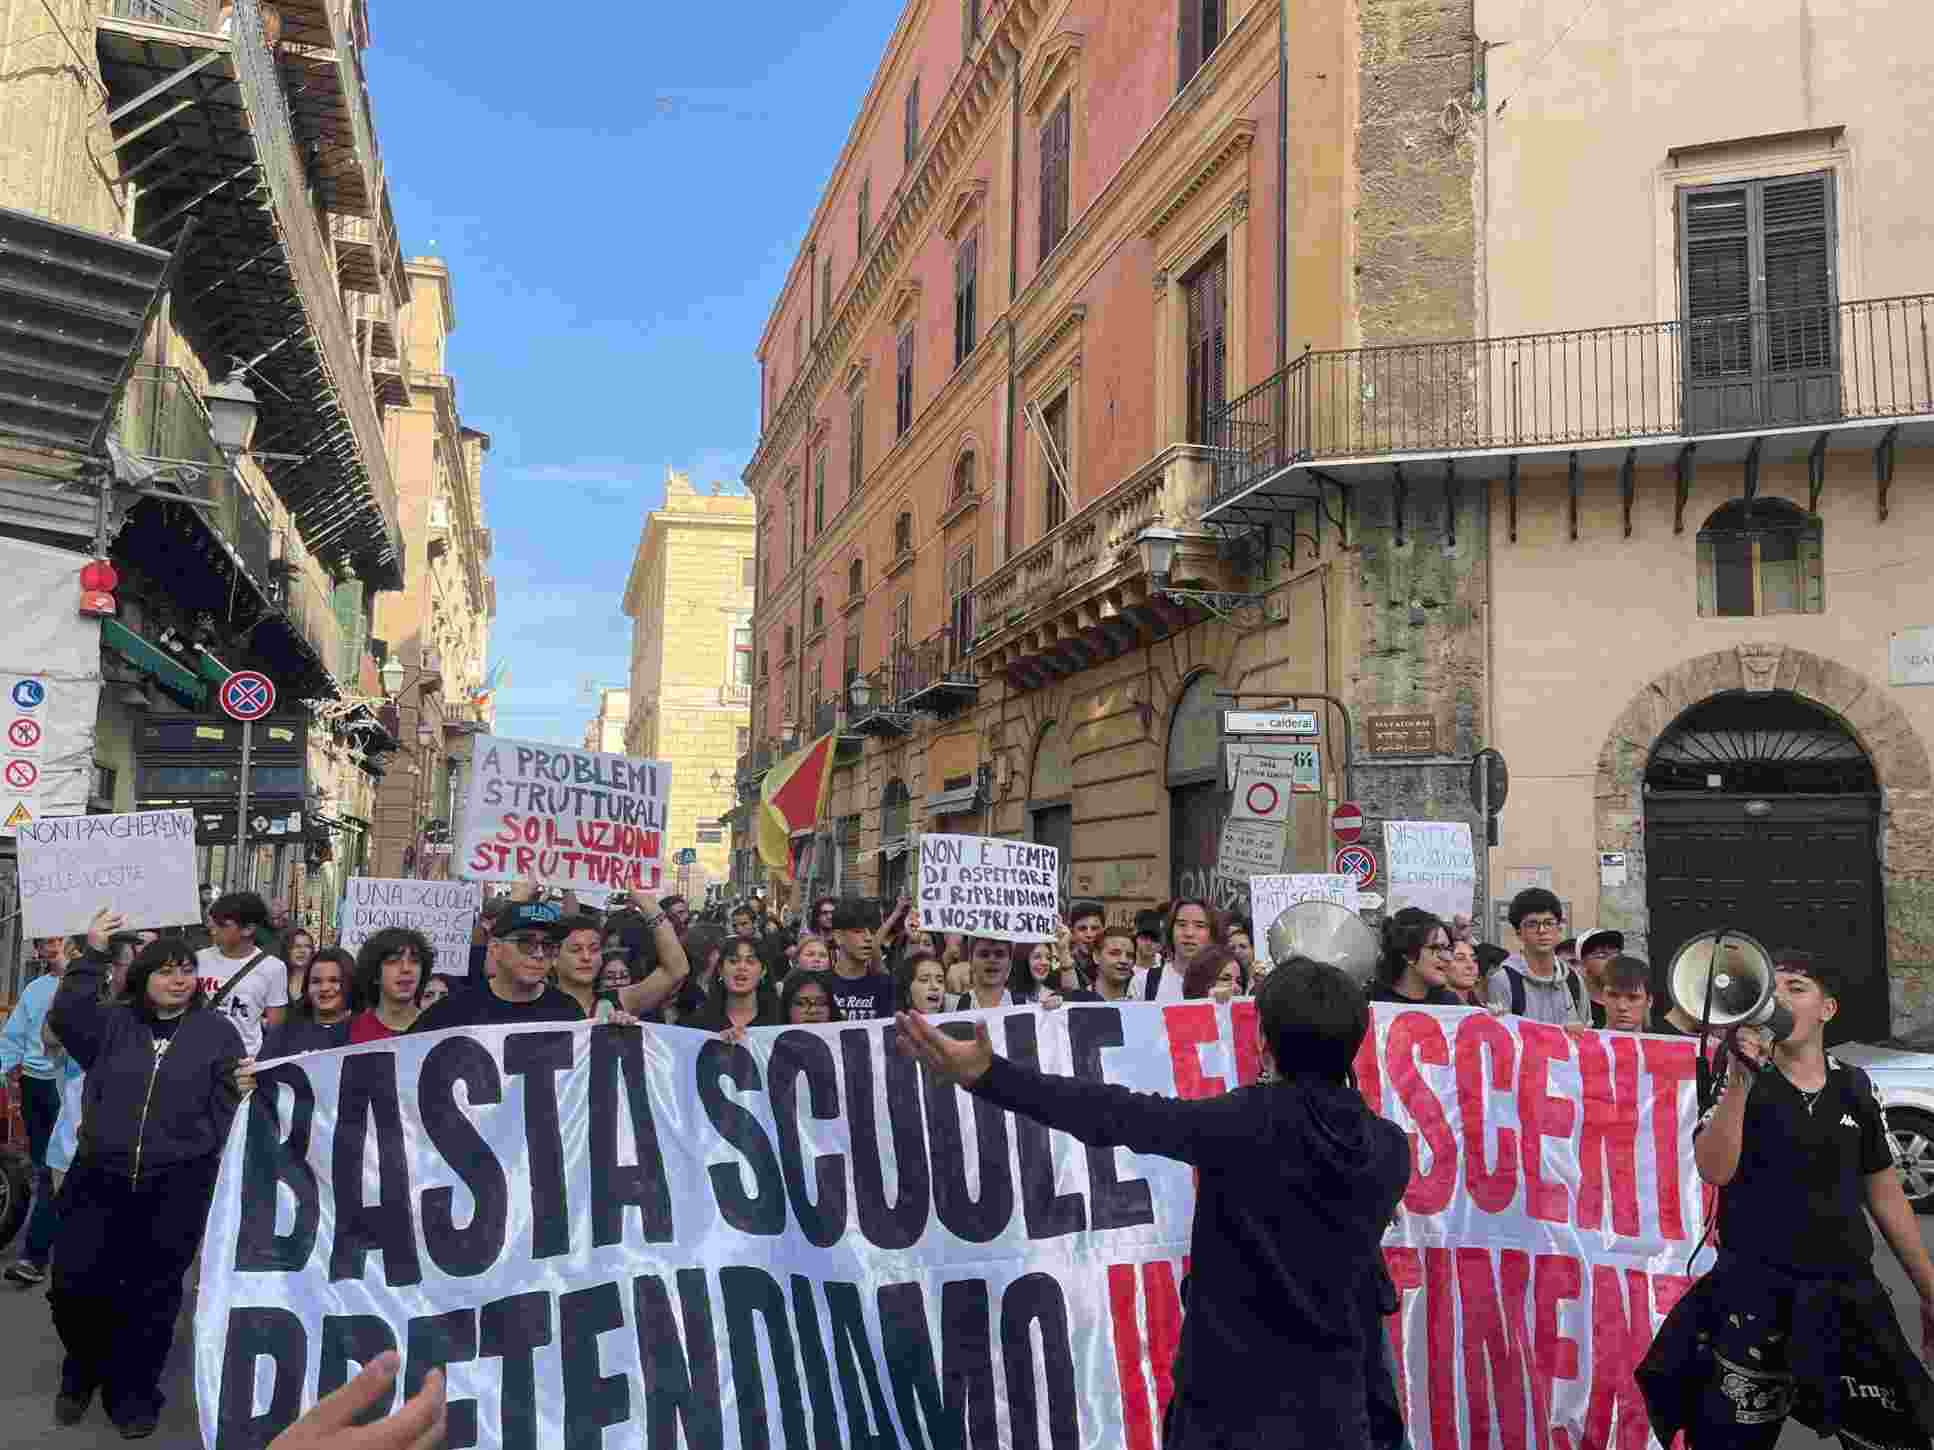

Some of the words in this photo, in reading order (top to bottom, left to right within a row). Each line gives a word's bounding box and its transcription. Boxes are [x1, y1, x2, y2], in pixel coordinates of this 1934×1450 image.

[481, 744, 501, 775] A
[515, 746, 658, 797] PROBLEMI
[483, 778, 668, 832] STRUTTURALI
[20, 821, 69, 844] NON
[496, 813, 660, 859] SOLUZIONI
[921, 839, 963, 865] NON
[1002, 844, 1056, 872] TEMPO
[923, 866, 948, 884] DI
[959, 867, 1051, 887] ASPETTARE
[357, 882, 403, 905] UNA
[922, 887, 941, 901] CI
[950, 886, 1055, 909] RIPRENDIAMO
[940, 907, 1011, 931] NOSTRI
[232, 1024, 675, 1287] BASTA
[695, 1005, 1155, 1250] SCUOLE
